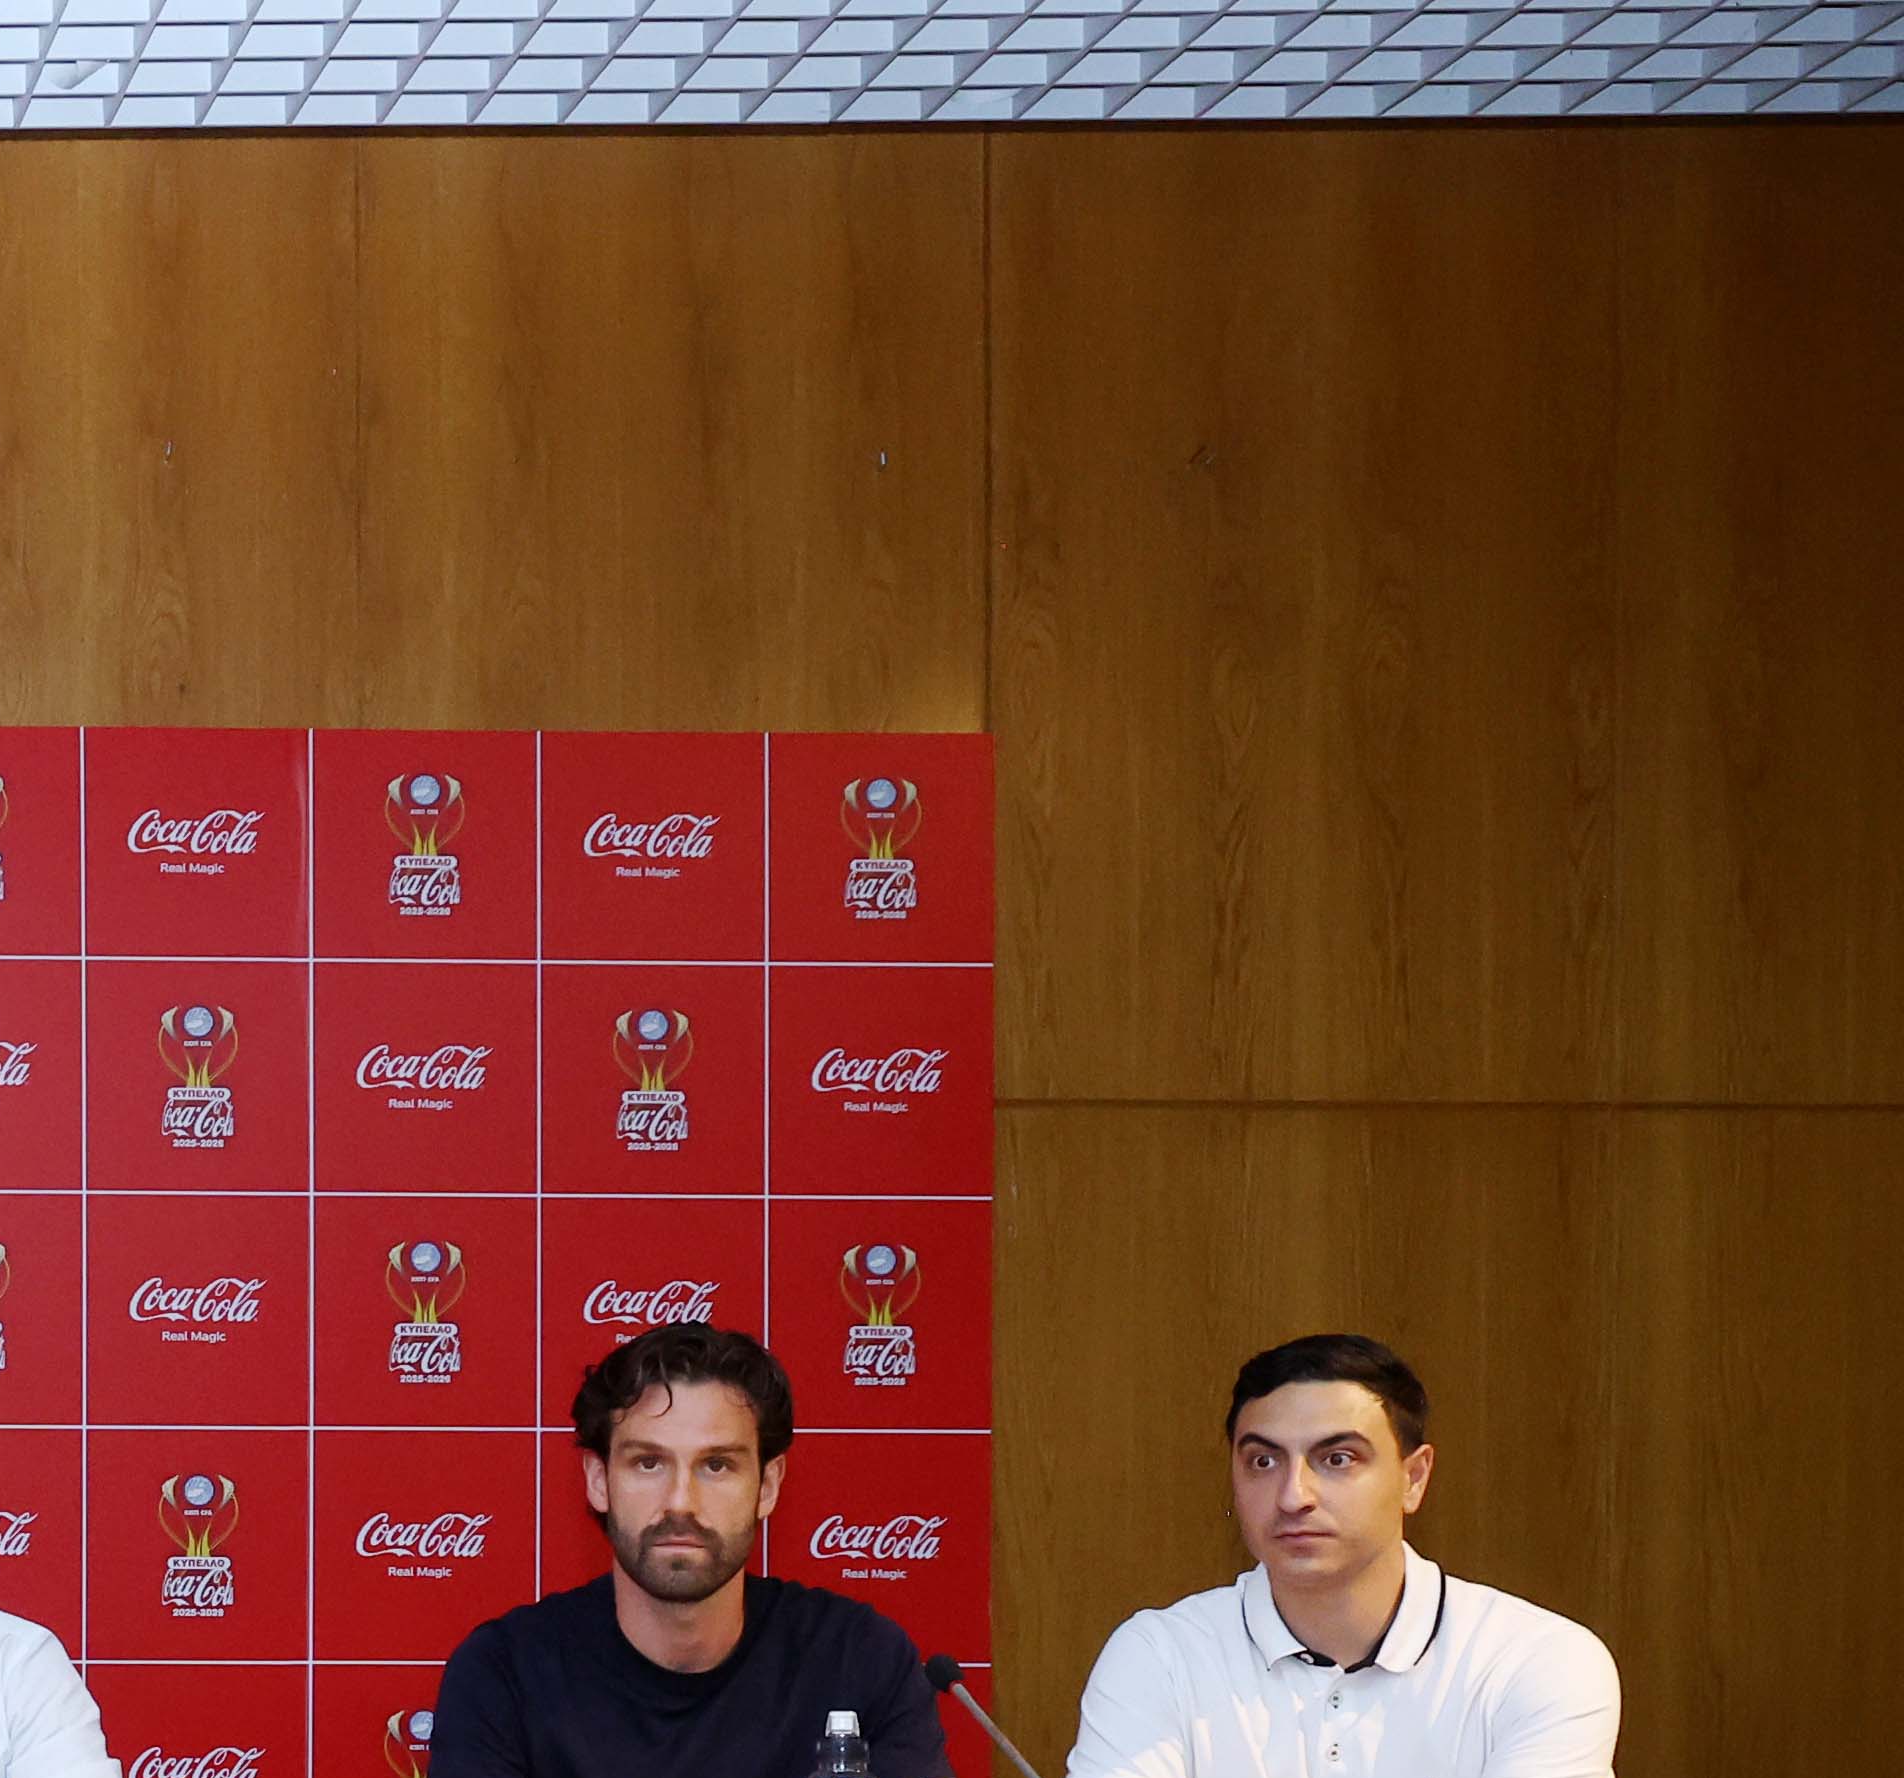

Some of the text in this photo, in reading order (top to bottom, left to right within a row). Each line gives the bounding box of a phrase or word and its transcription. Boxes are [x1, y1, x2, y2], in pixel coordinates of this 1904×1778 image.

[128, 809, 265, 854] Coca-Cola
[584, 813, 721, 858] Coca-Cola
[160, 863, 224, 876] Real Magic
[356, 1045, 493, 1089] Coca-Cola
[811, 1048, 950, 1092] Coca-Cola
[173, 1089, 224, 1099] ΚΥΠΕΛΛΟ
[162, 1098, 233, 1138] Coca-Cola
[129, 1278, 267, 1322] Coca-Cola
[583, 1280, 720, 1325] Coca-Cola
[162, 1331, 226, 1344] Real Magic
[356, 1513, 493, 1557] Coca-Cola
[810, 1515, 948, 1559] Coca-Cola
[173, 1558, 224, 1568] ΚΥΠΕΛΛΟ
[388, 1566, 452, 1580] Real Magic
[842, 1569, 907, 1582] Real Magic
[162, 1567, 233, 1607] Coca-Cola
